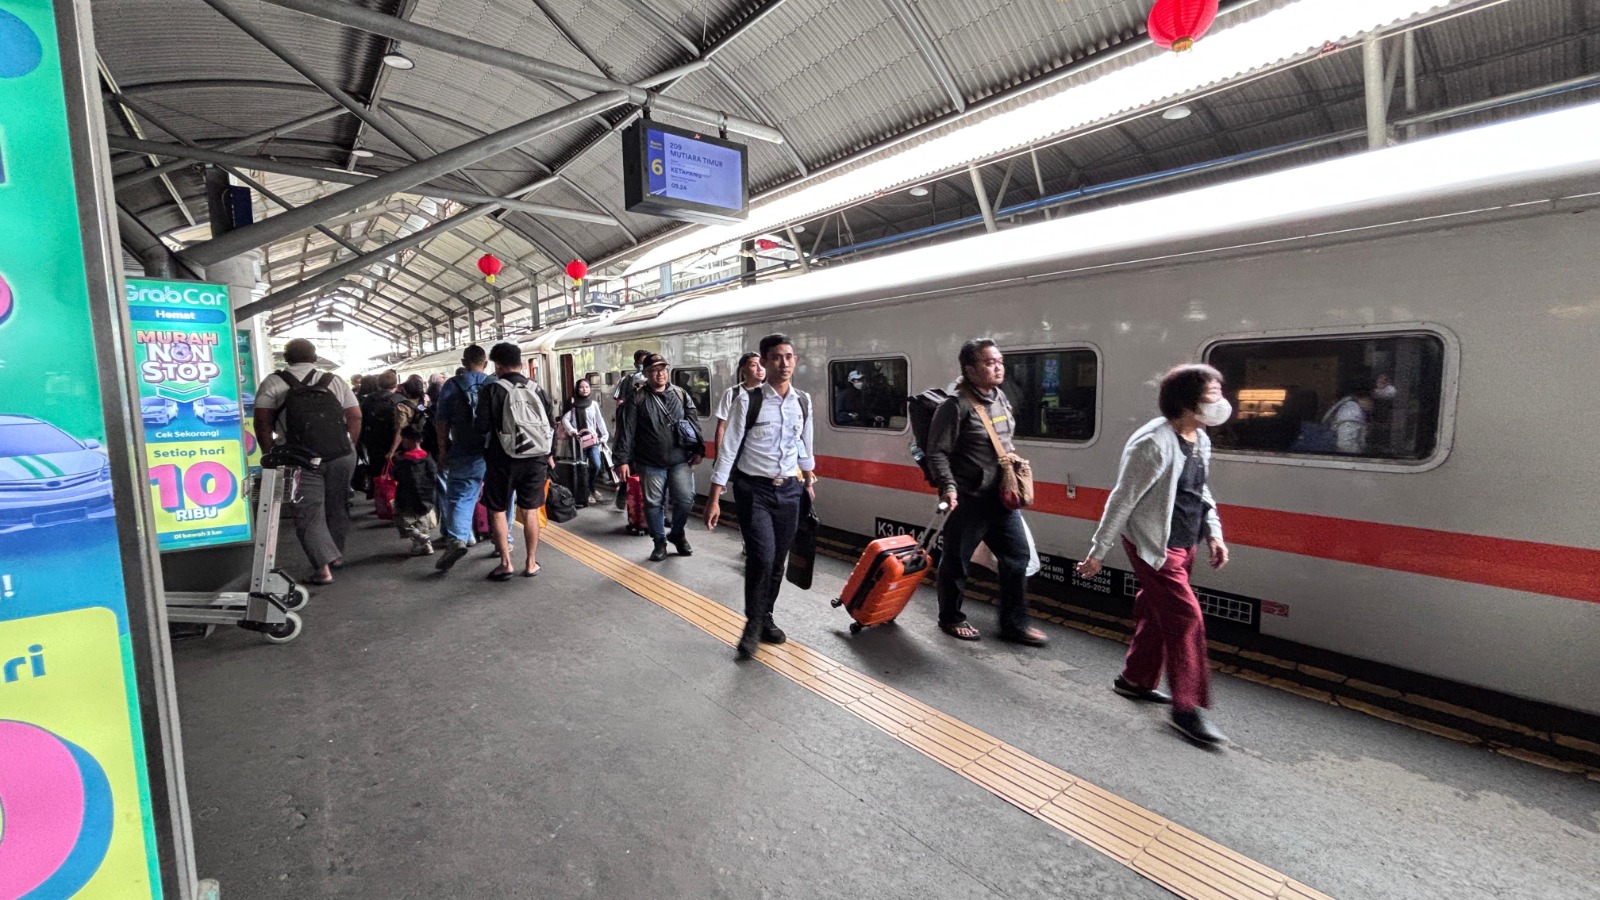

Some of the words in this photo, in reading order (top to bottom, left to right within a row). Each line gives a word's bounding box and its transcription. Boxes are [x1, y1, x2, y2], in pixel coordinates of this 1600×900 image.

[669, 142, 682, 150] 209
[670, 150, 701, 162] MUTIARA
[703, 158, 723, 168] TIMUR
[652, 158, 663, 176] 6
[670, 182, 687, 190] 09.24
[126, 285, 226, 306] GrabCar
[156, 310, 196, 320] Hemat
[136, 330, 218, 344] MURAH
[142, 361, 220, 383] STOP
[174, 430, 220, 439] Sekarang!
[154, 450, 196, 460] Setiap
[200, 447, 225, 456] hari
[148, 461, 237, 513] 10
[176, 506, 217, 520] RIBU
[878, 520, 894, 537] K3
[1052, 566, 1064, 574] MRI
[1052, 573, 1064, 582] YAD
